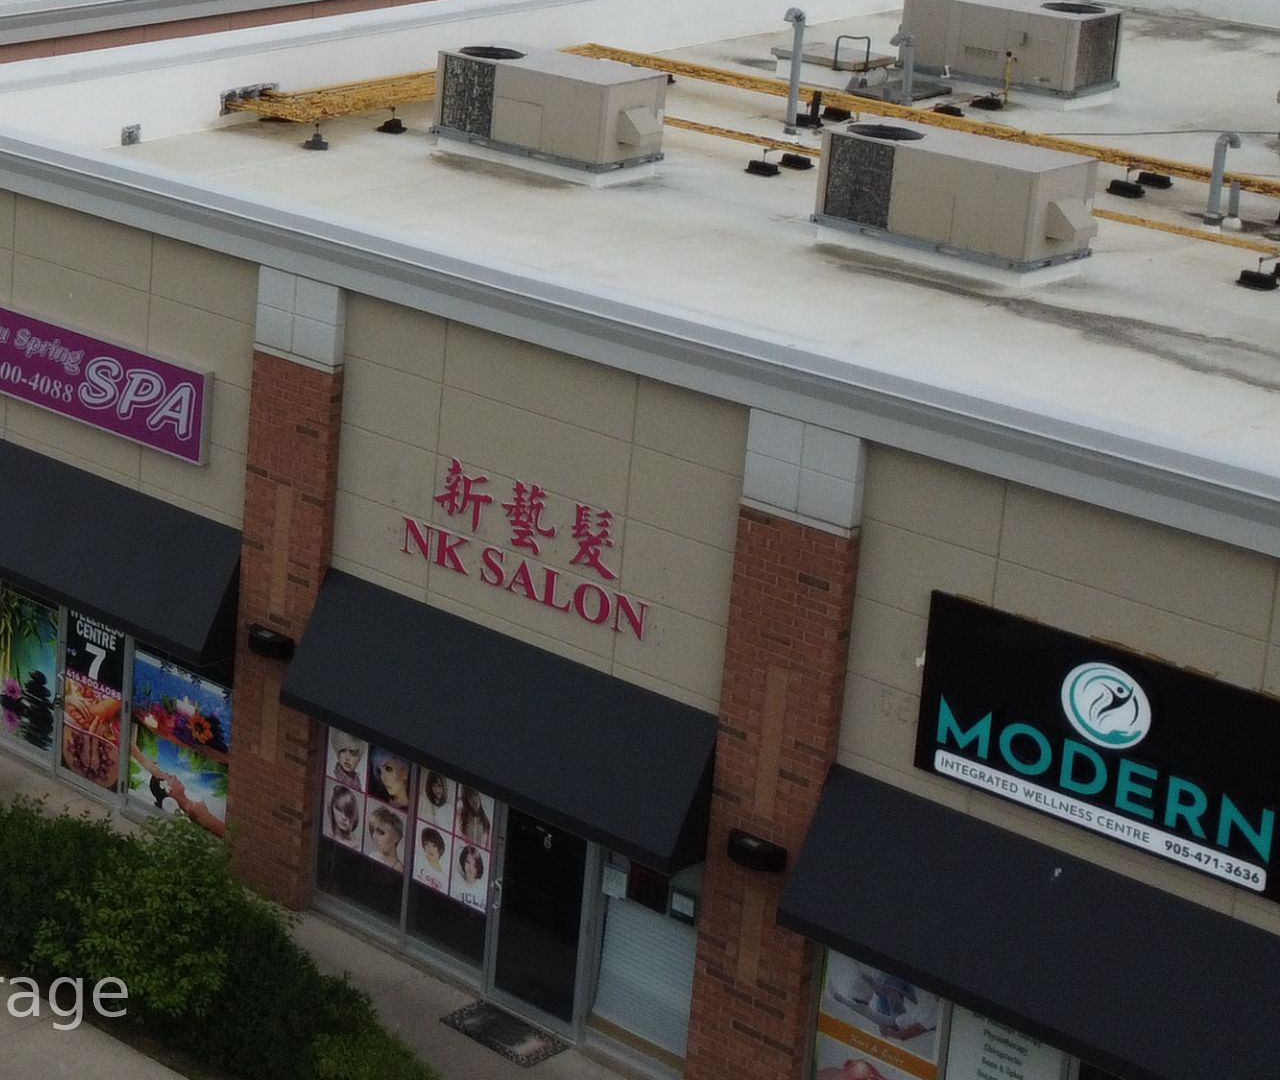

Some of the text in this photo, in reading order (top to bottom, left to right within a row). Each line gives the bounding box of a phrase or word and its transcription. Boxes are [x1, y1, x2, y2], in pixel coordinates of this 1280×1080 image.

[13, 327, 85, 375] Spring
[77, 356, 197, 441] SPA
[400, 516, 651, 642] NK SALON
[76, 620, 117, 651] CENTRE
[85, 642, 107, 681] 7
[936, 693, 1276, 864] MODERN
[940, 756, 1261, 885] INTEGRATED WELLNESS CENTRE 905-471-3636
